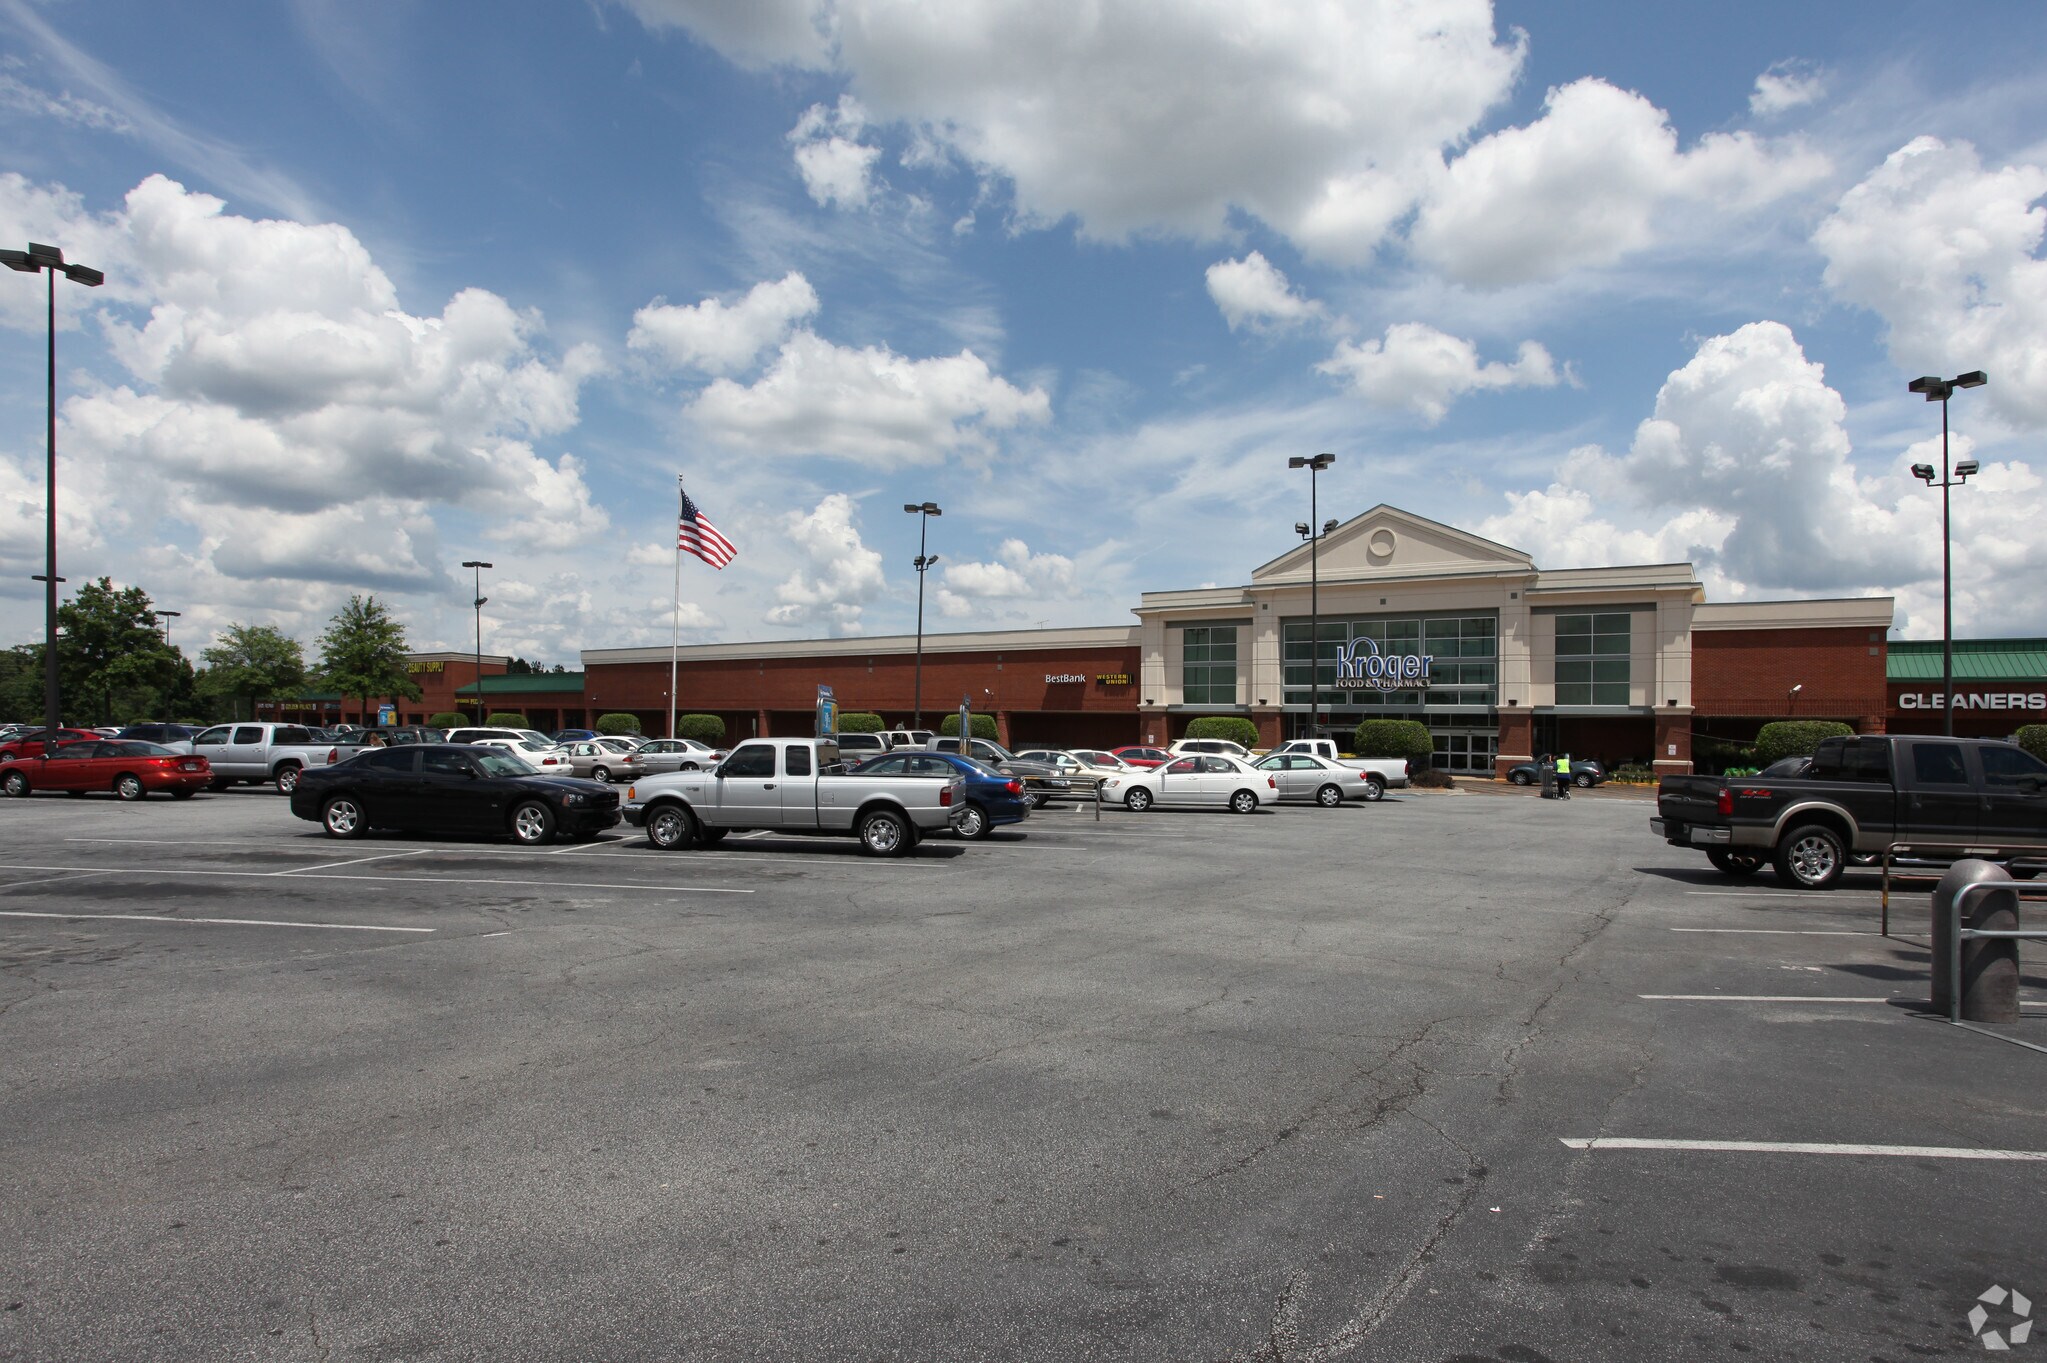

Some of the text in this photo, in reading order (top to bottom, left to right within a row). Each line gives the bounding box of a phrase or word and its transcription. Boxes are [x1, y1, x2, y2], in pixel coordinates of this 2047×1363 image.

[426, 662, 444, 673] SUPPLY
[1336, 636, 1434, 693] Kroger
[1045, 673, 1086, 683] BestBank
[1335, 679, 1432, 688] FOOD & PHARMACY
[1898, 693, 2047, 709] CLEANERS
